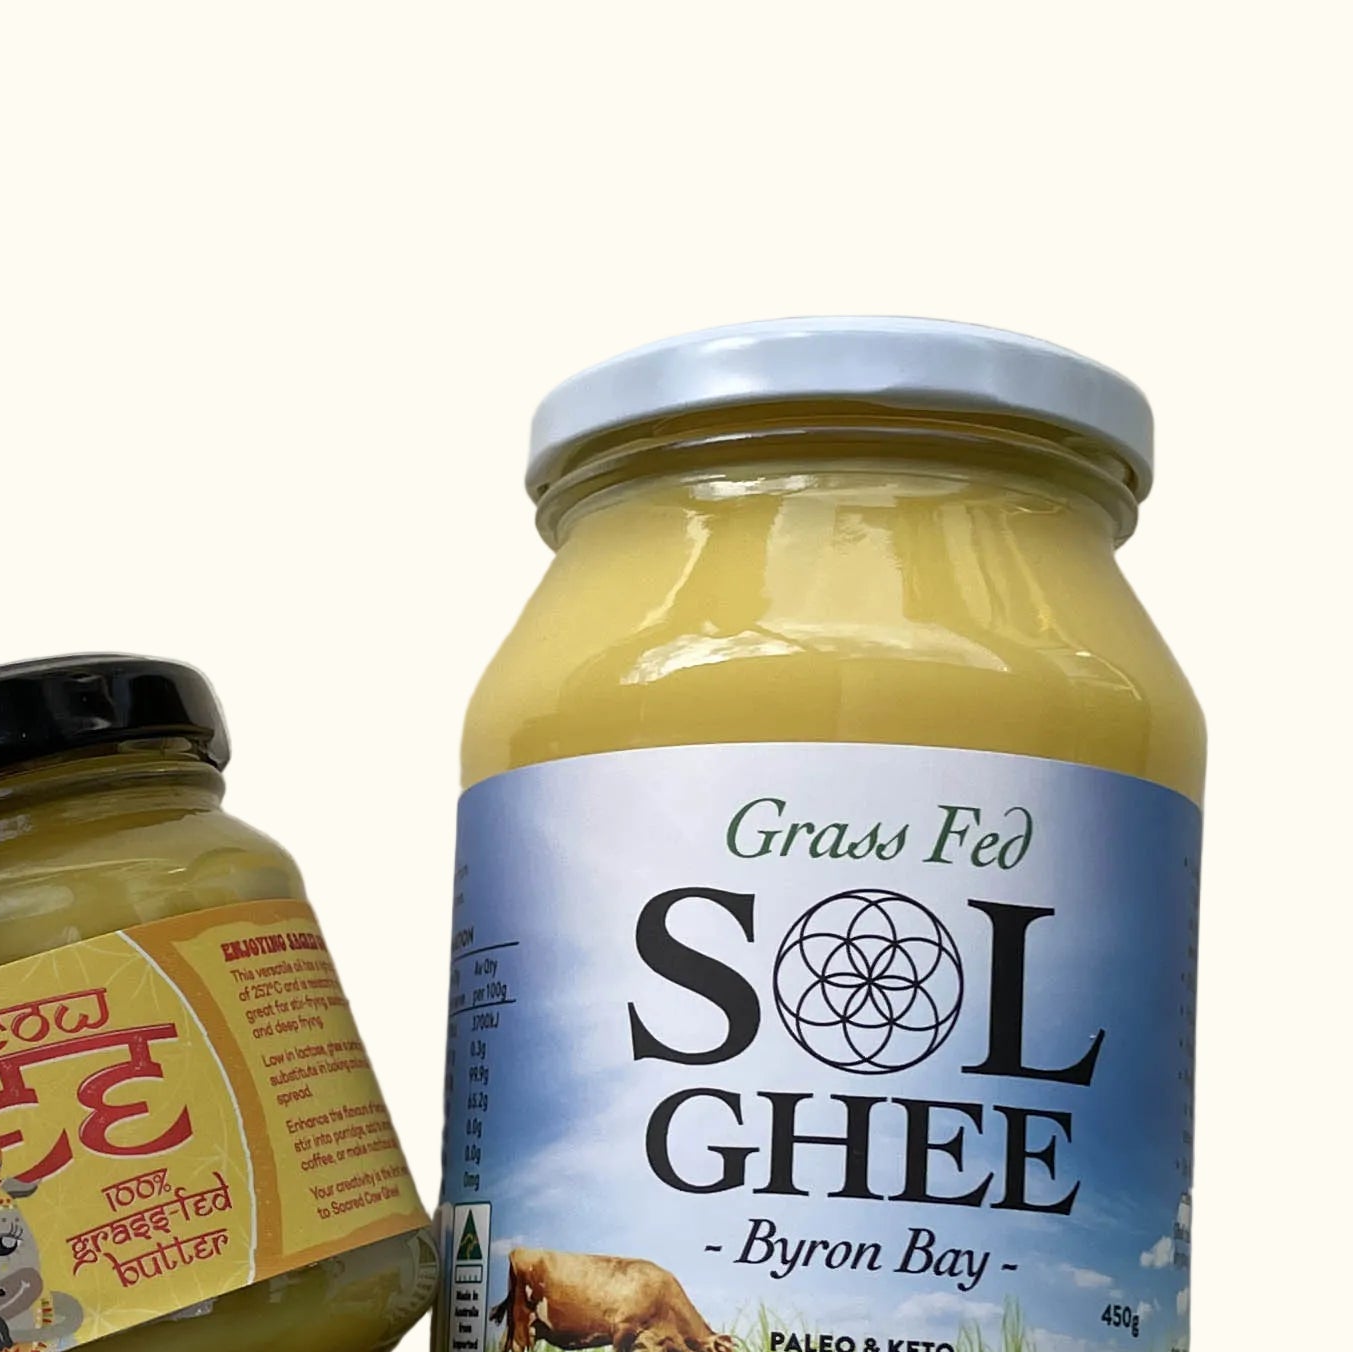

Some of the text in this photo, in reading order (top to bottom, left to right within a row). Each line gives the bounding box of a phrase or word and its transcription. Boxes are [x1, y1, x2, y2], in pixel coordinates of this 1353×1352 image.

[726, 798, 1034, 870] Grass Fed
[486, 981, 507, 1001] 100g
[627, 887, 1106, 1087] SOL
[245, 1006, 275, 1024] great
[253, 1021, 274, 1039] and
[275, 1019, 299, 1037] deep
[262, 1053, 285, 1068] Low
[285, 1050, 296, 1062] in
[285, 1112, 329, 1134] Enhance
[294, 1138, 312, 1154] stir
[312, 1132, 333, 1148] into
[645, 1087, 1082, 1216] GHEE
[101, 1168, 172, 1213] 100%
[309, 1185, 335, 1201] Your
[66, 1171, 232, 1276] grass-fed
[317, 1206, 331, 1220] to
[104, 1228, 229, 1288] butter
[733, 1218, 881, 1280] Byron
[893, 1227, 990, 1292] Bay
[1102, 1304, 1141, 1338] 450g
